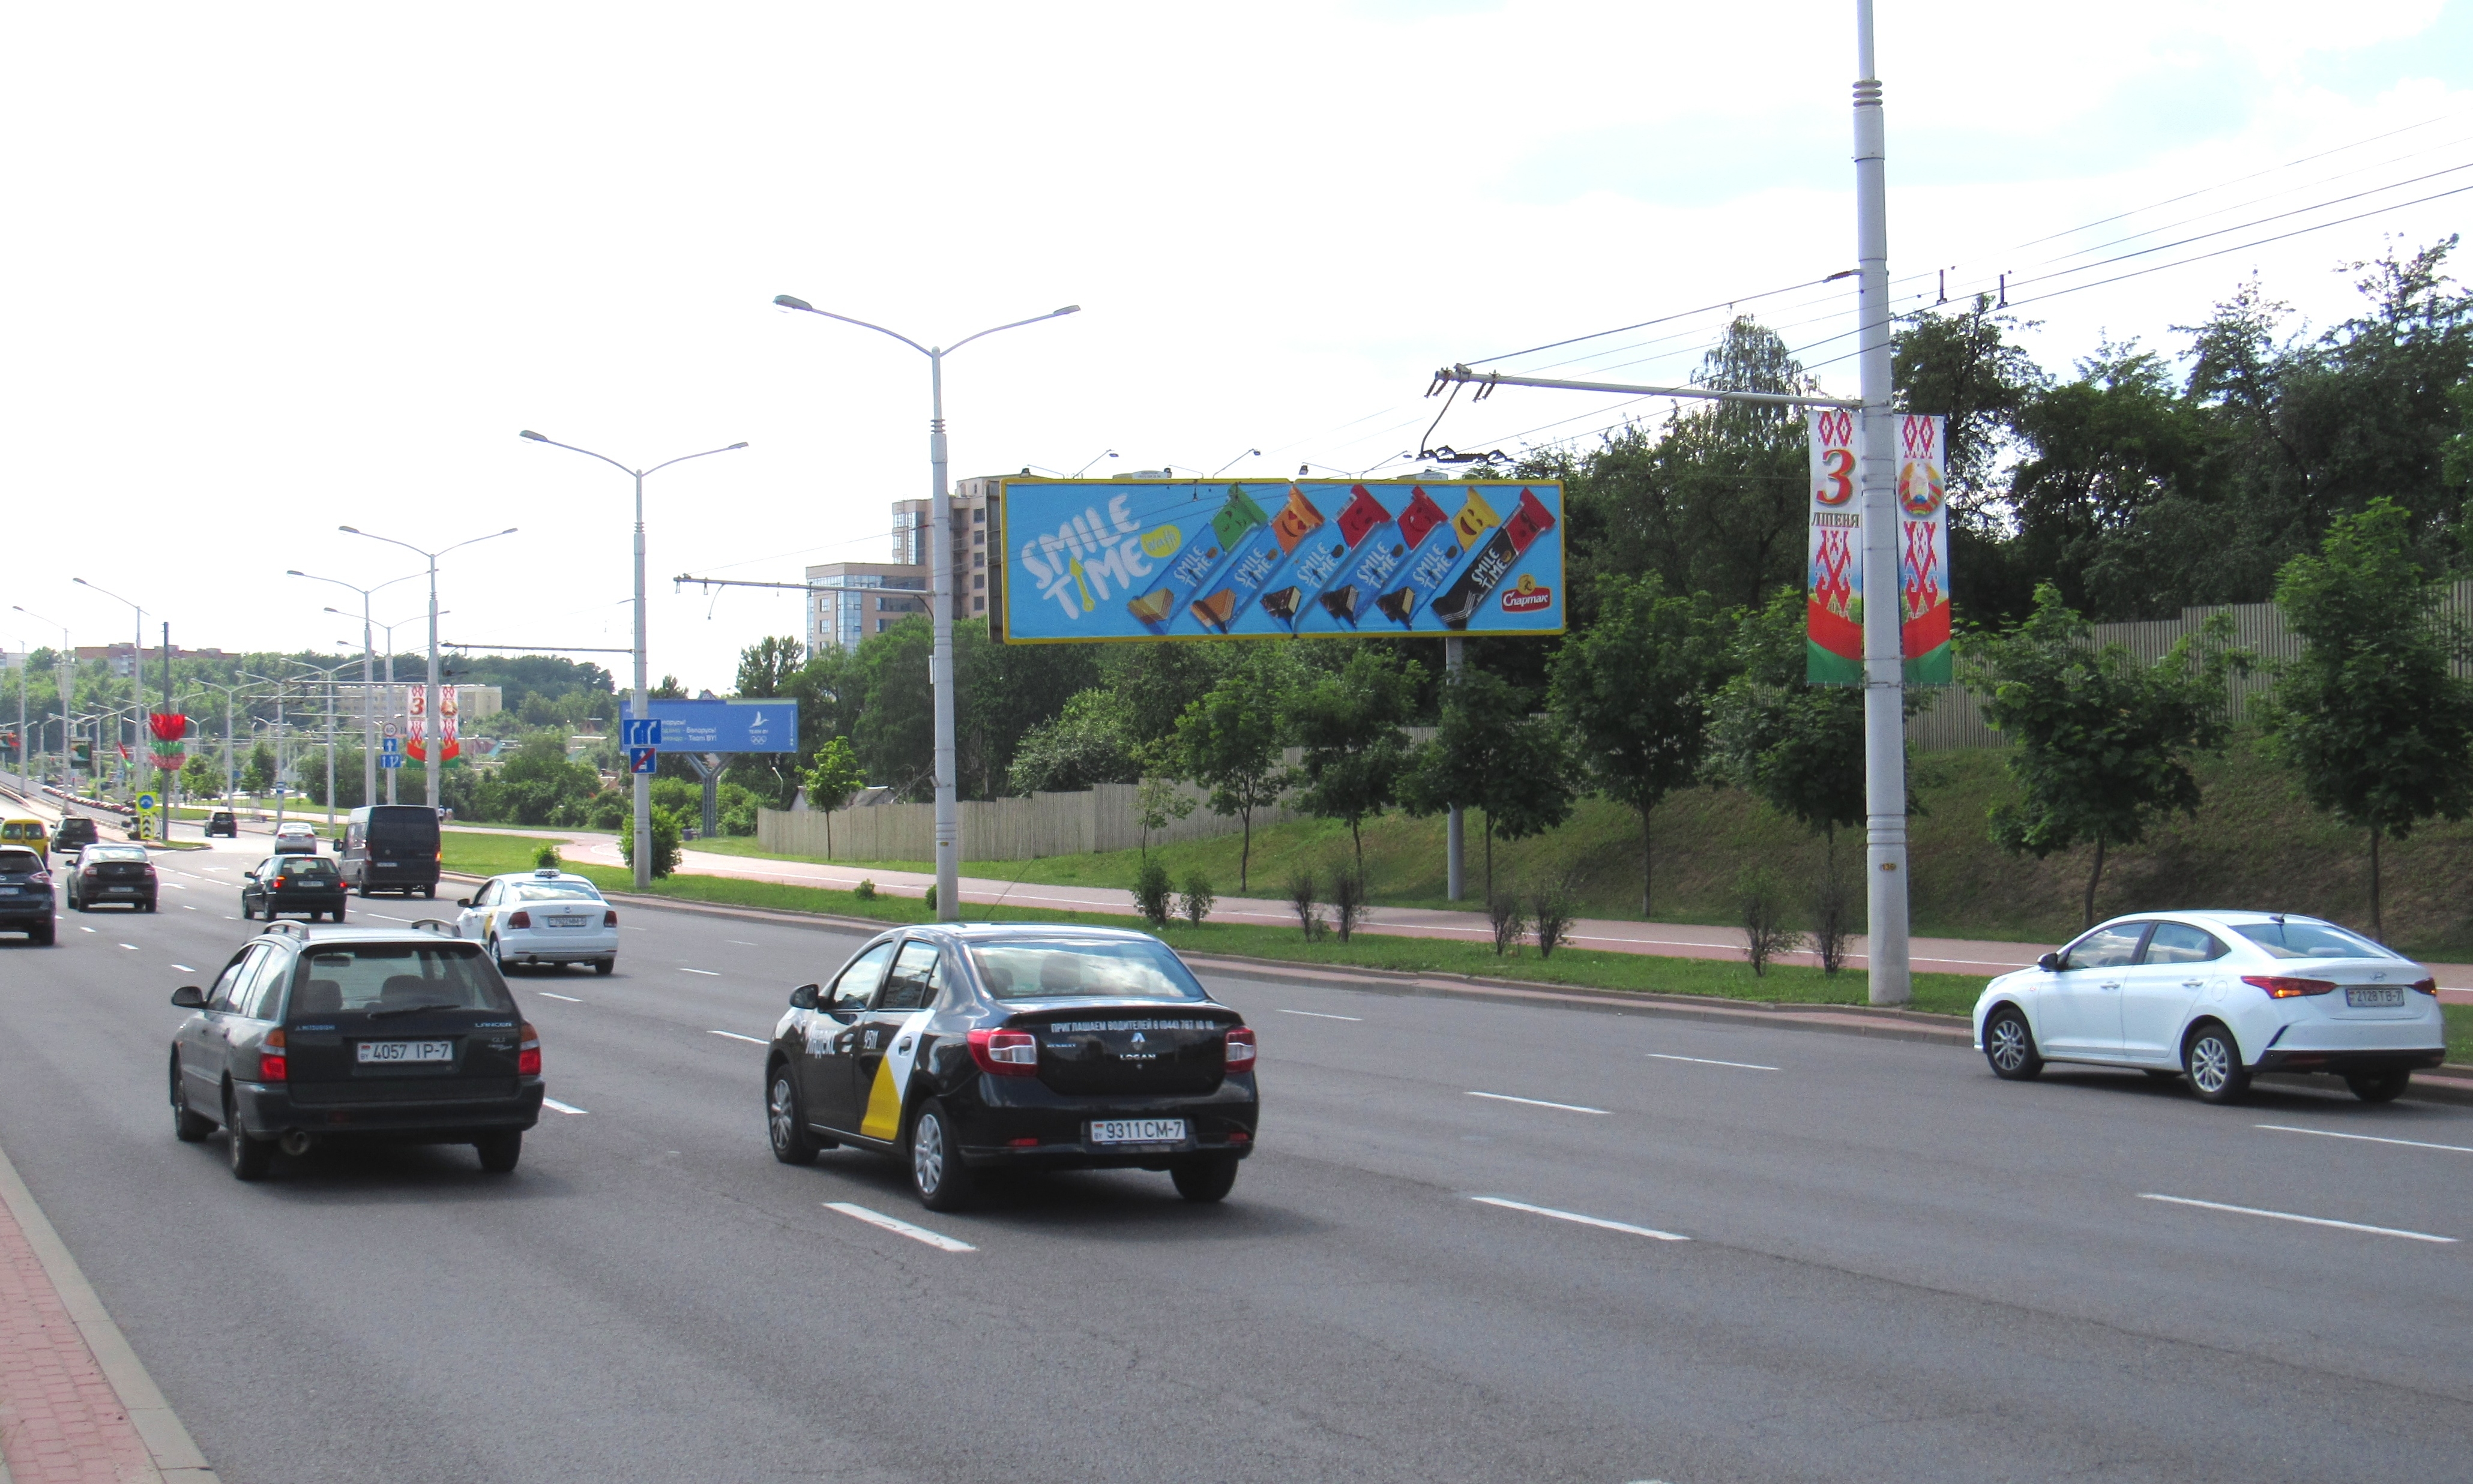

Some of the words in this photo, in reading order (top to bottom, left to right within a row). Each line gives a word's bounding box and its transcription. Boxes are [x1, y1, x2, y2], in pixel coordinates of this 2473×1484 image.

[1816, 448, 1855, 507] 3
[1811, 512, 1860, 528] ЛІПЕНЯ
[1022, 493, 1140, 589] SMILE
[1043, 536, 1153, 620] TIME
[1173, 545, 1204, 582] SMILE
[1234, 547, 1265, 584] SMILE
[1297, 542, 1329, 584] SMILE
[1357, 541, 1389, 583] SMILE
[1412, 543, 1444, 584] SMILE
[1471, 547, 1499, 585] SMILE
[1503, 591, 1548, 607] Спартак
[411, 697, 424, 715] 3
[1052, 1021, 1106, 1033] ПРИГЛАШАЕМ
[1107, 1018, 1152, 1031] ВОДИТЕЛЕЙ
[373, 1044, 407, 1060] 4057
